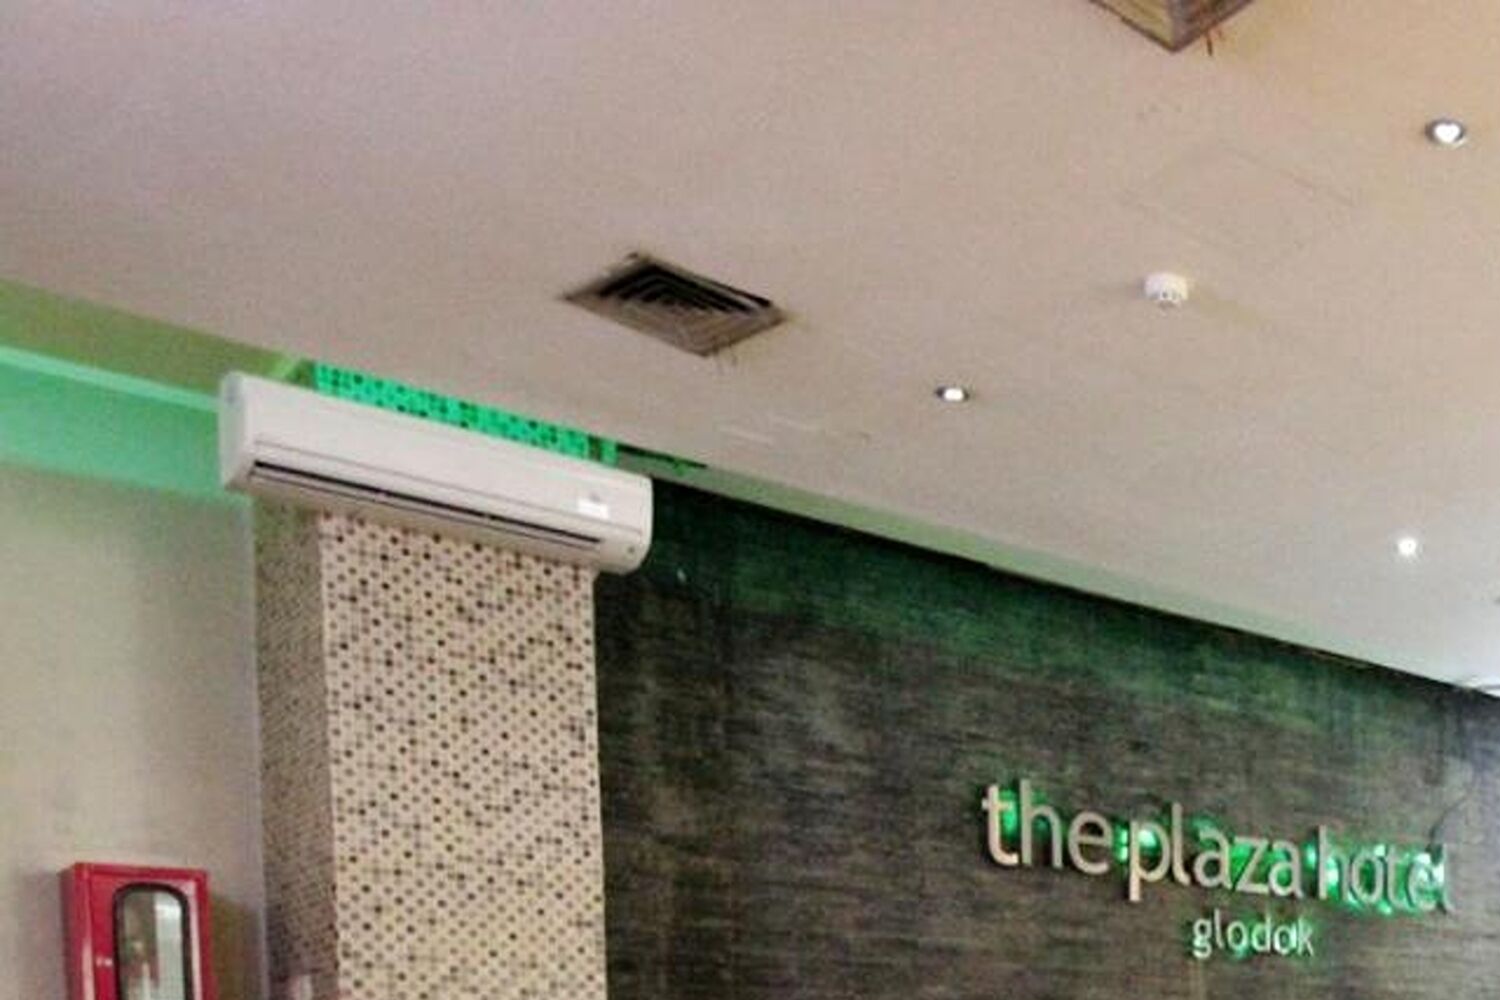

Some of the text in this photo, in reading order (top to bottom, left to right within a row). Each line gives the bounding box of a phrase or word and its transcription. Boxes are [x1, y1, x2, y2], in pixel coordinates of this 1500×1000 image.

[982, 778, 1452, 912] the plaza hotel
[1192, 910, 1315, 959] glodok
